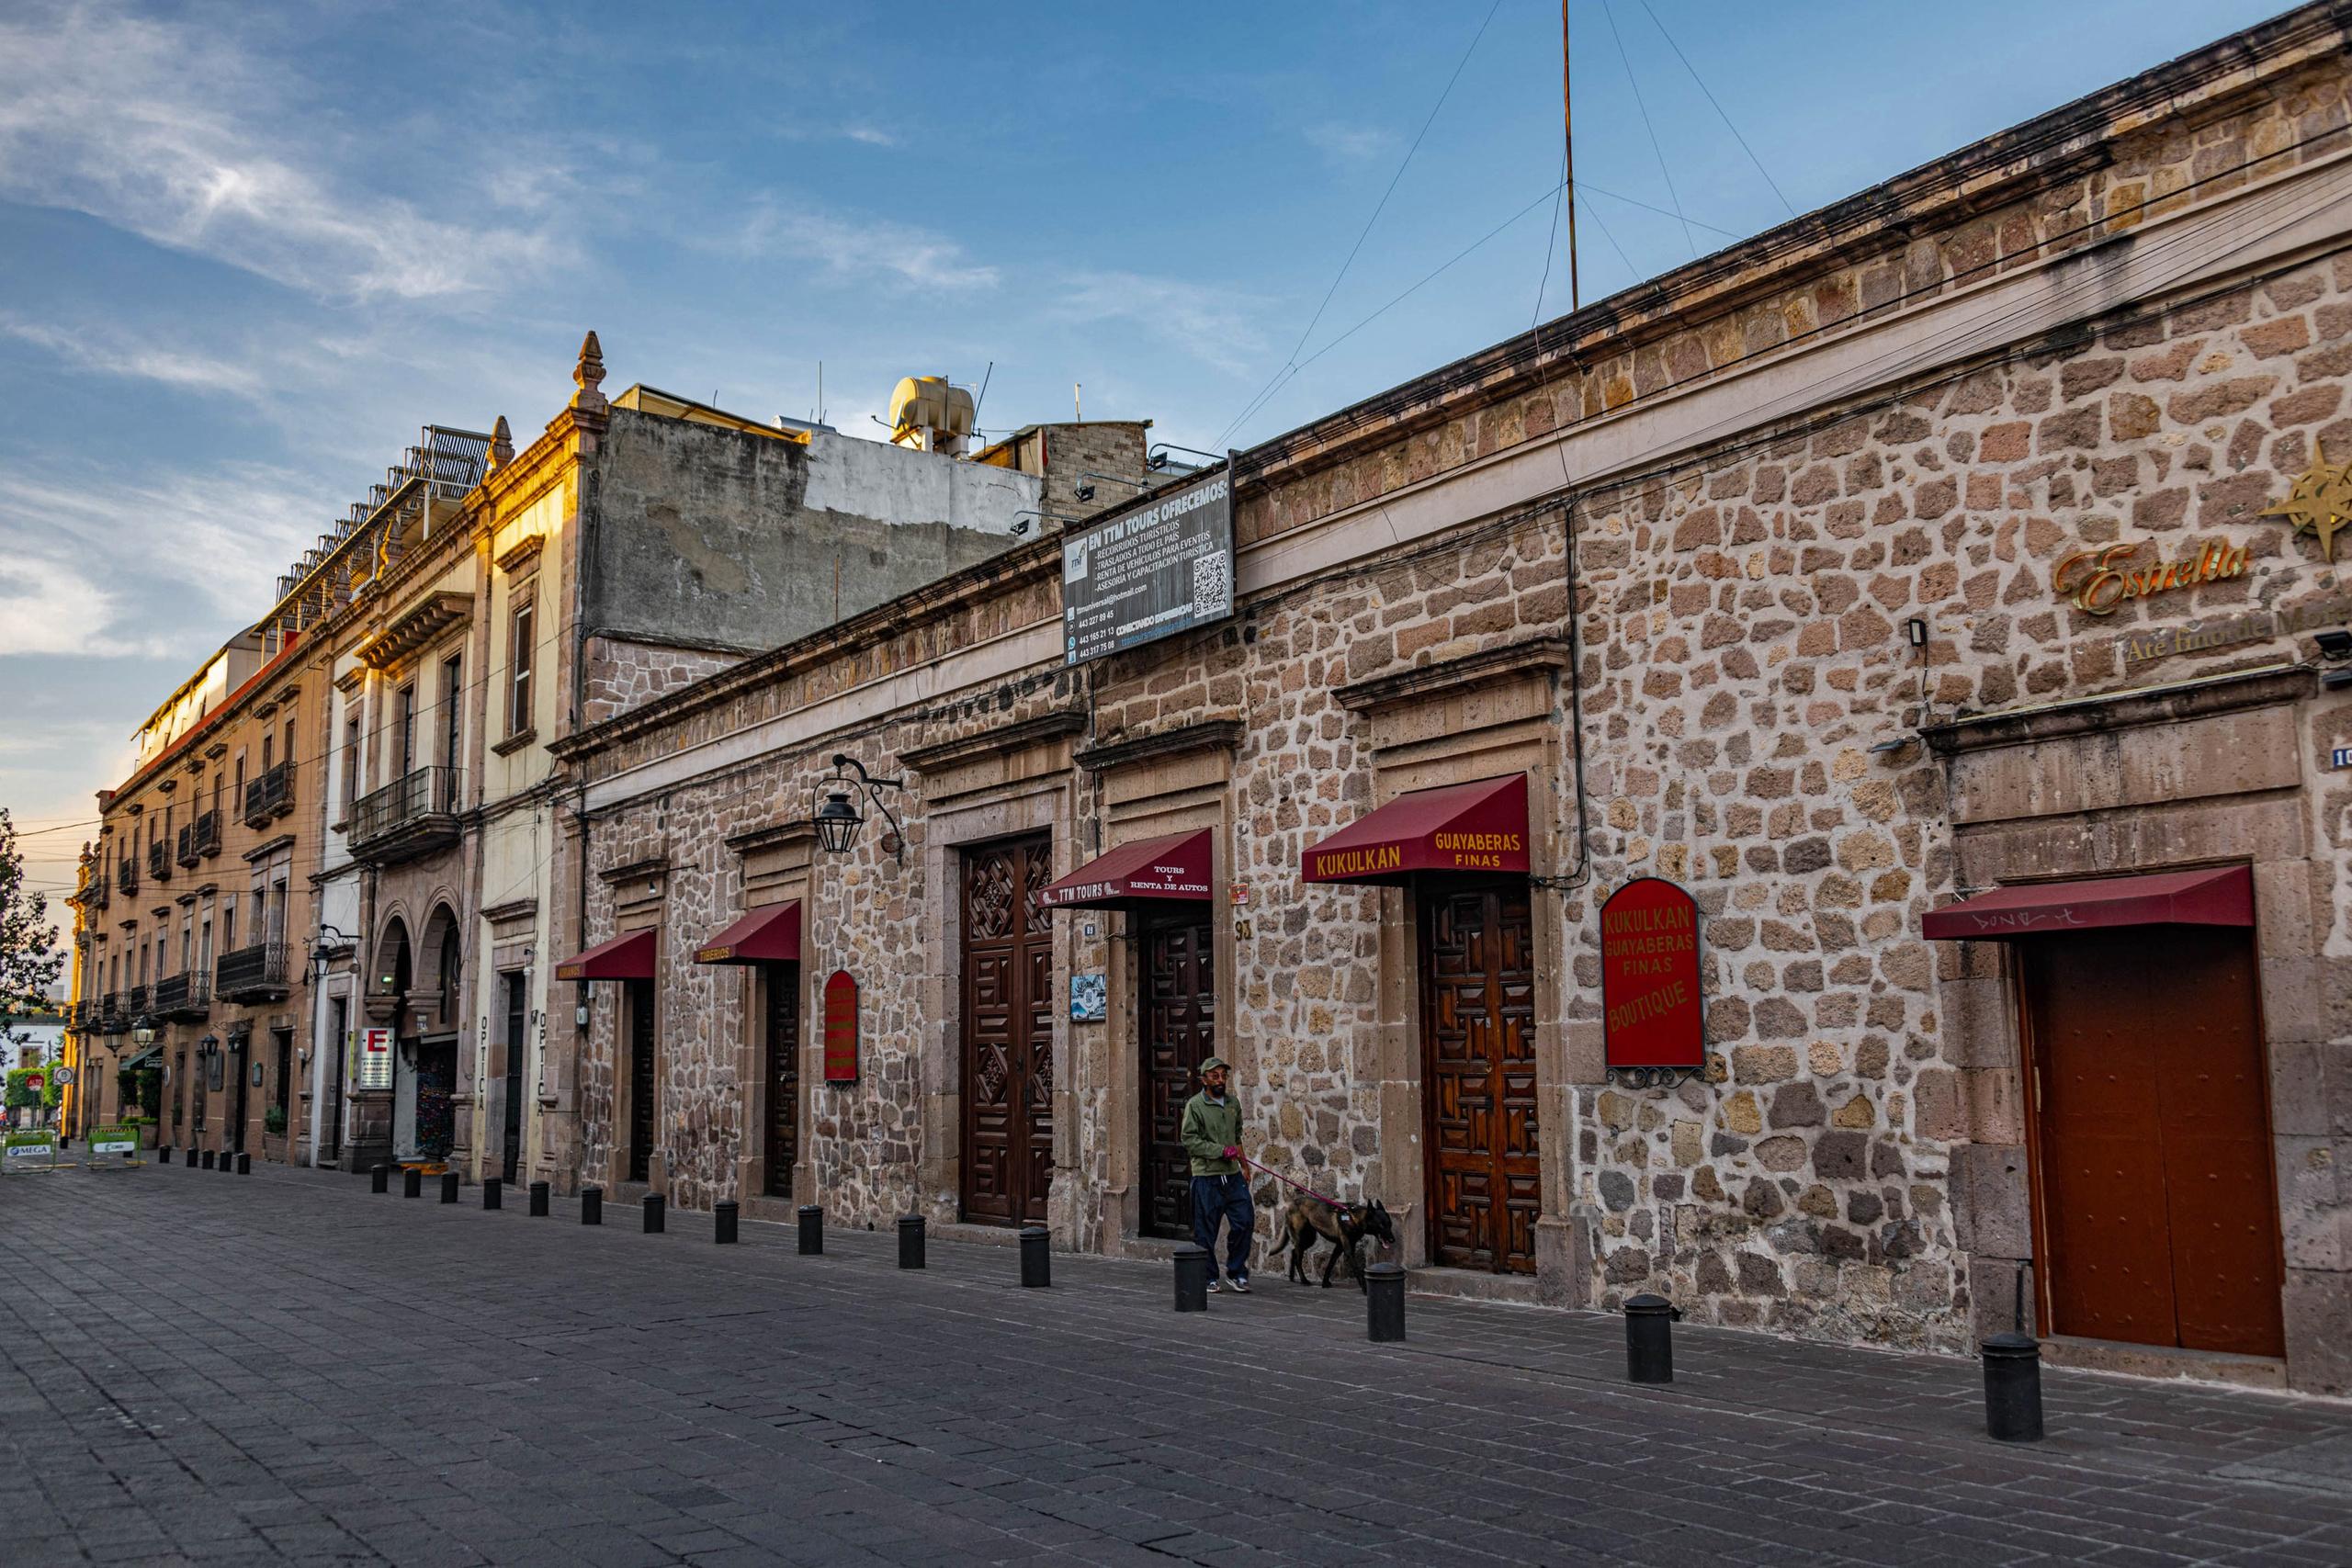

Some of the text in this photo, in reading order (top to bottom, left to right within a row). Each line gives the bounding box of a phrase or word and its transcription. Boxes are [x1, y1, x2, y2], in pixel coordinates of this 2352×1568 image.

[1088, 480, 1227, 551] EN TTM TOURS OFRECEMOS:
[1140, 519, 1180, 543] TURÍSTICOS
[1118, 563, 1125, 574] DE
[1126, 549, 1161, 570] VEHÍCULOS
[1162, 543, 1180, 557] PARA
[1181, 530, 1211, 549] EVENTOS
[1133, 548, 1137, 558] A
[1138, 541, 1155, 554] TODO
[1156, 538, 1163, 547] EL
[1165, 531, 1180, 545] PAÍS
[1126, 571, 1132, 581] Y
[1132, 554, 1178, 579] CAPACITACIÓN
[1180, 541, 1214, 561] TURÍSTICA
[2052, 538, 2250, 615] Estrella
[1079, 619, 1089, 628] 443
[1089, 615, 1099, 626] 227
[1107, 610, 1114, 619] 45
[1080, 635, 1089, 645] 443
[1100, 629, 1106, 638] 21
[1108, 626, 1114, 636] 13
[2126, 638, 2167, 662] Ate
[2175, 627, 2226, 652] fino
[2235, 616, 2267, 640] de
[1080, 649, 1089, 658] 443
[1091, 645, 1100, 655] 317
[1101, 642, 1107, 651] 75
[1435, 833, 1521, 852] GUAYABERAS
[1317, 843, 1400, 876] KUKULKÁN
[1455, 854, 1500, 867] FINAS
[1058, 883, 1102, 902] TTM TOURS
[1130, 881, 1162, 889] RENTA
[1179, 884, 1208, 892] AUTOS
[700, 946, 729, 963] TIBERIOS
[1605, 933, 1694, 957] GUAYABERAS
[1623, 957, 1673, 976] FINAS
[1609, 980, 1689, 1032] BOUTIQUE
[368, 1030, 388, 1053] E
[479, 1016, 487, 1111] OPTICA
[28, 1078, 42, 1087] ALTO
